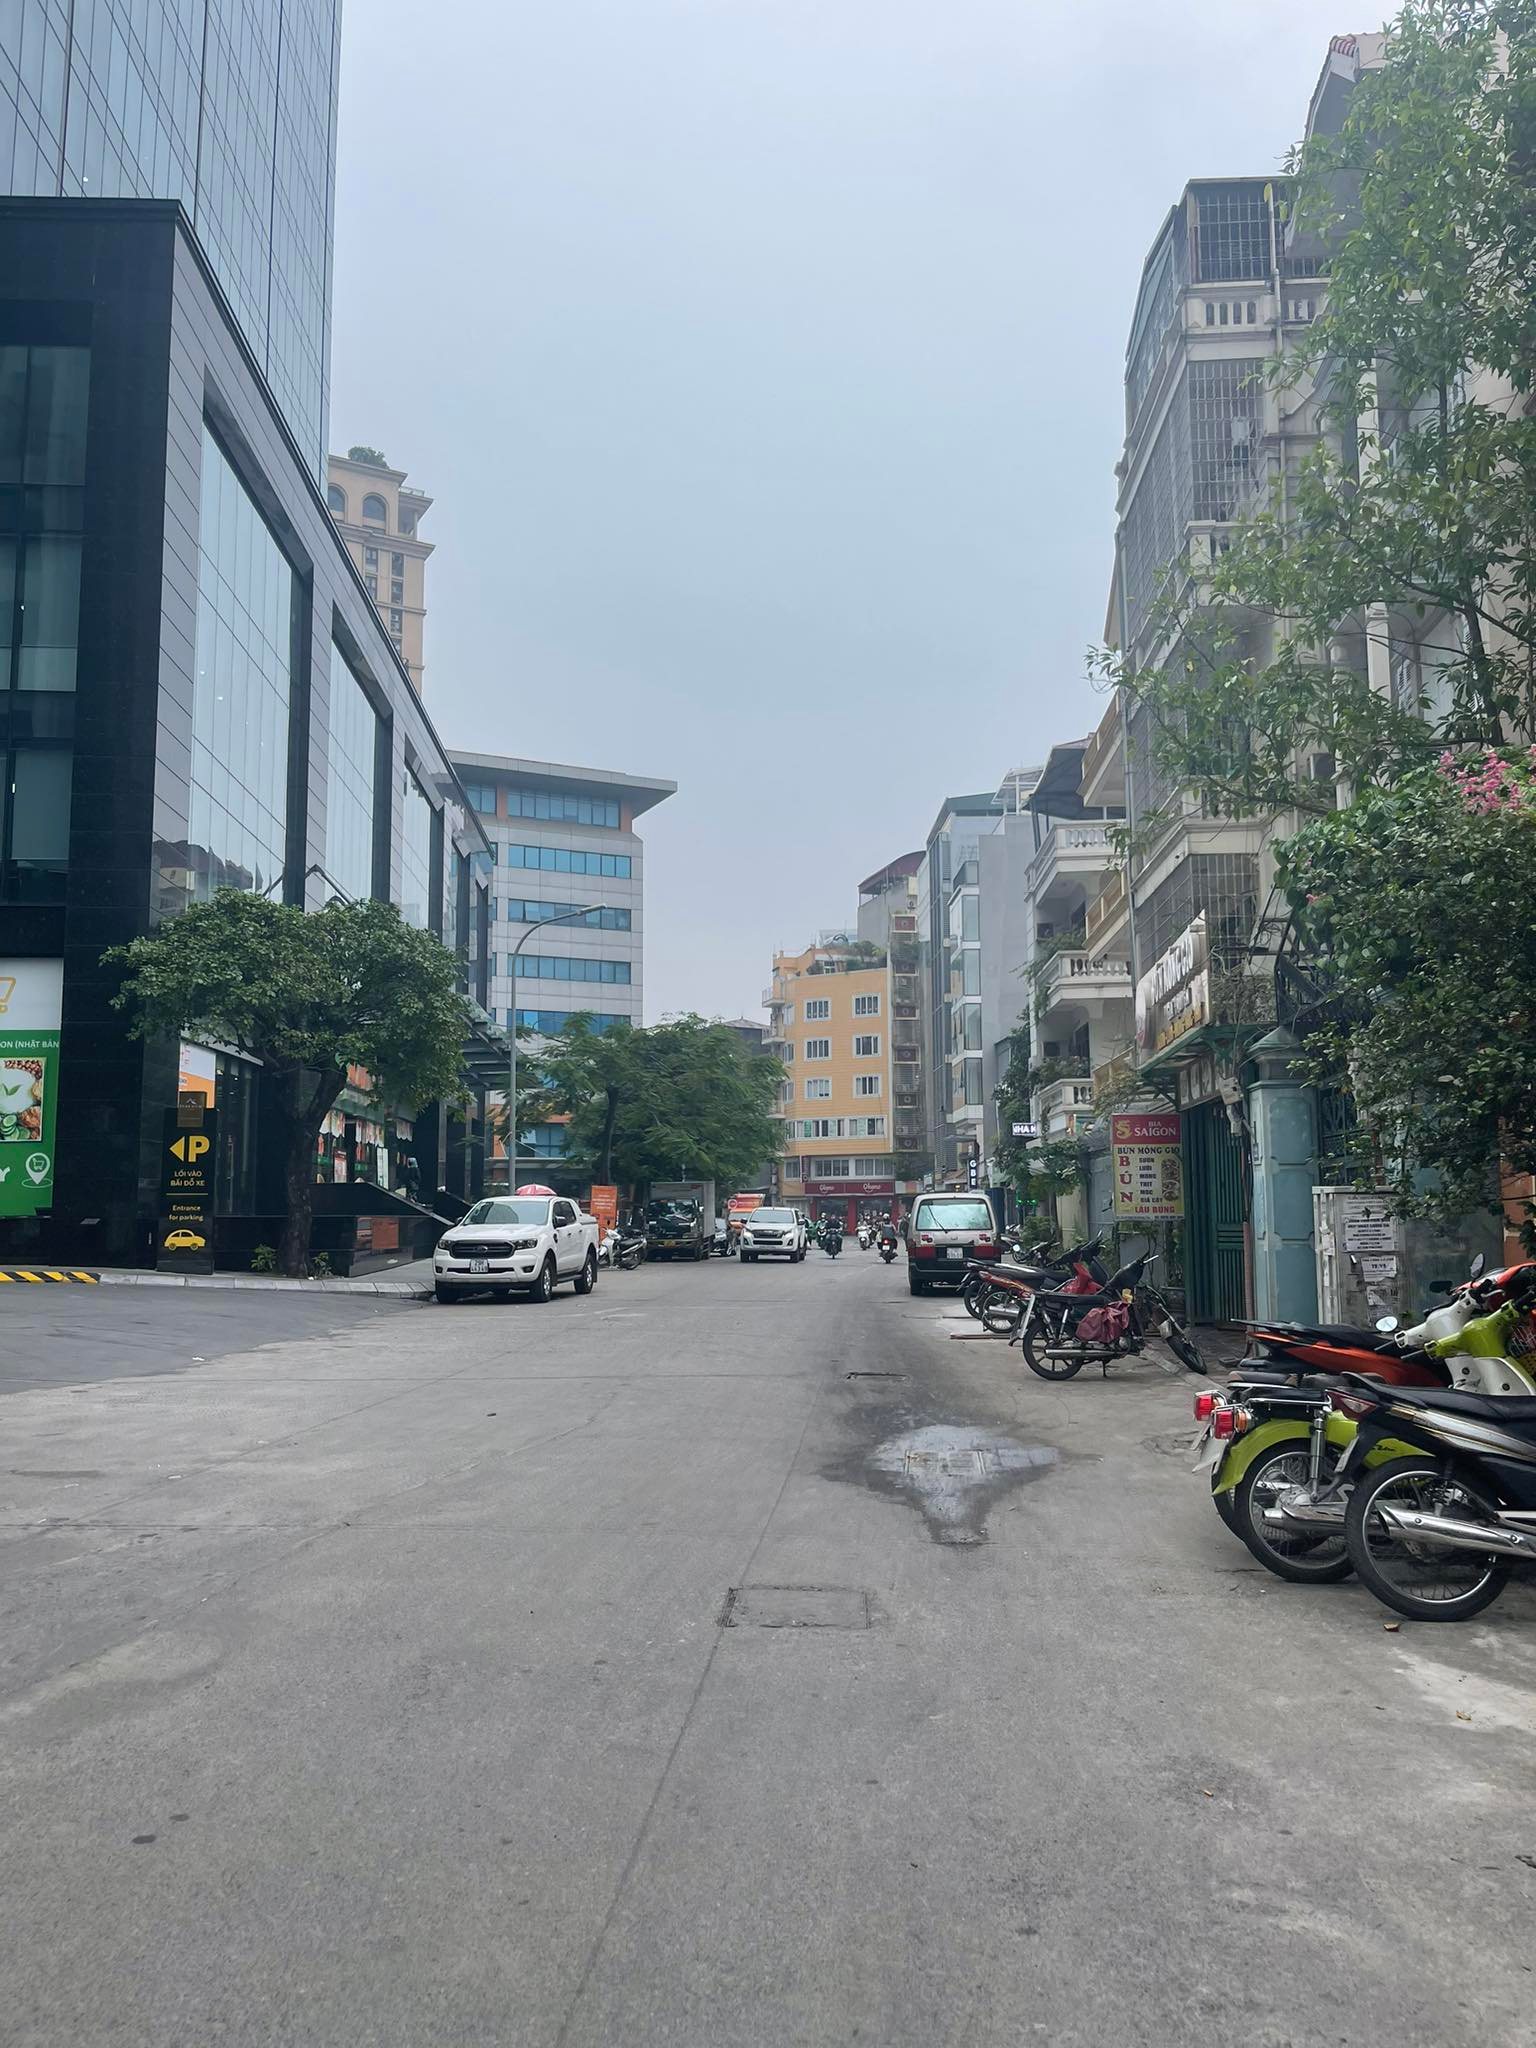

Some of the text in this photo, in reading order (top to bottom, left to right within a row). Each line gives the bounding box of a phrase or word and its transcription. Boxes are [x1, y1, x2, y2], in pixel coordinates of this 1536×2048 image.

[1134, 1127, 1176, 1137] SAIGON
[189, 1136, 210, 1162] P
[179, 1214, 204, 1222] parking
